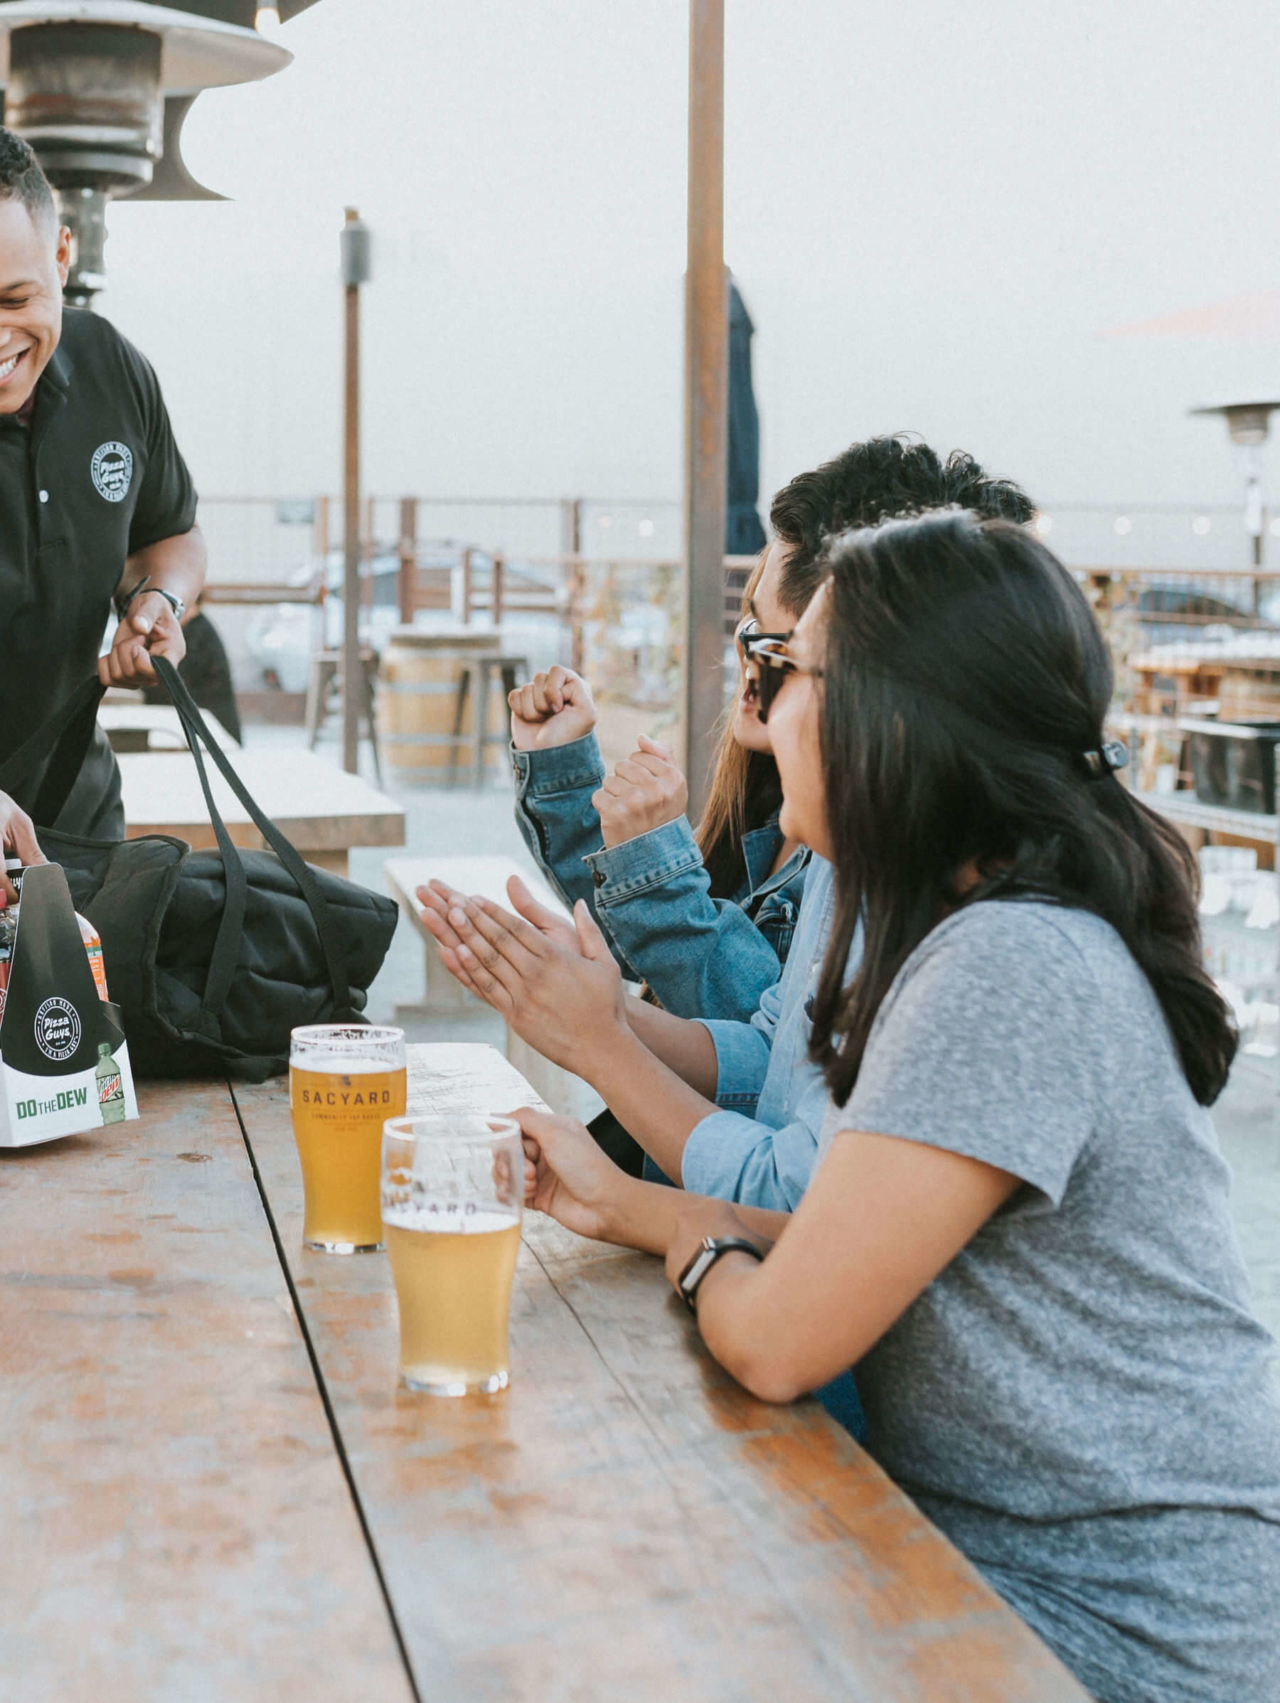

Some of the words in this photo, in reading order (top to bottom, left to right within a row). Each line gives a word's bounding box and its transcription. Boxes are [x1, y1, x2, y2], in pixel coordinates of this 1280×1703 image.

[44, 1017, 70, 1030] Pizza
[16, 1098, 38, 1120] DO
[37, 1099, 57, 1116] THE
[56, 1086, 88, 1111] DEW
[302, 1089, 390, 1106] SACYARD
